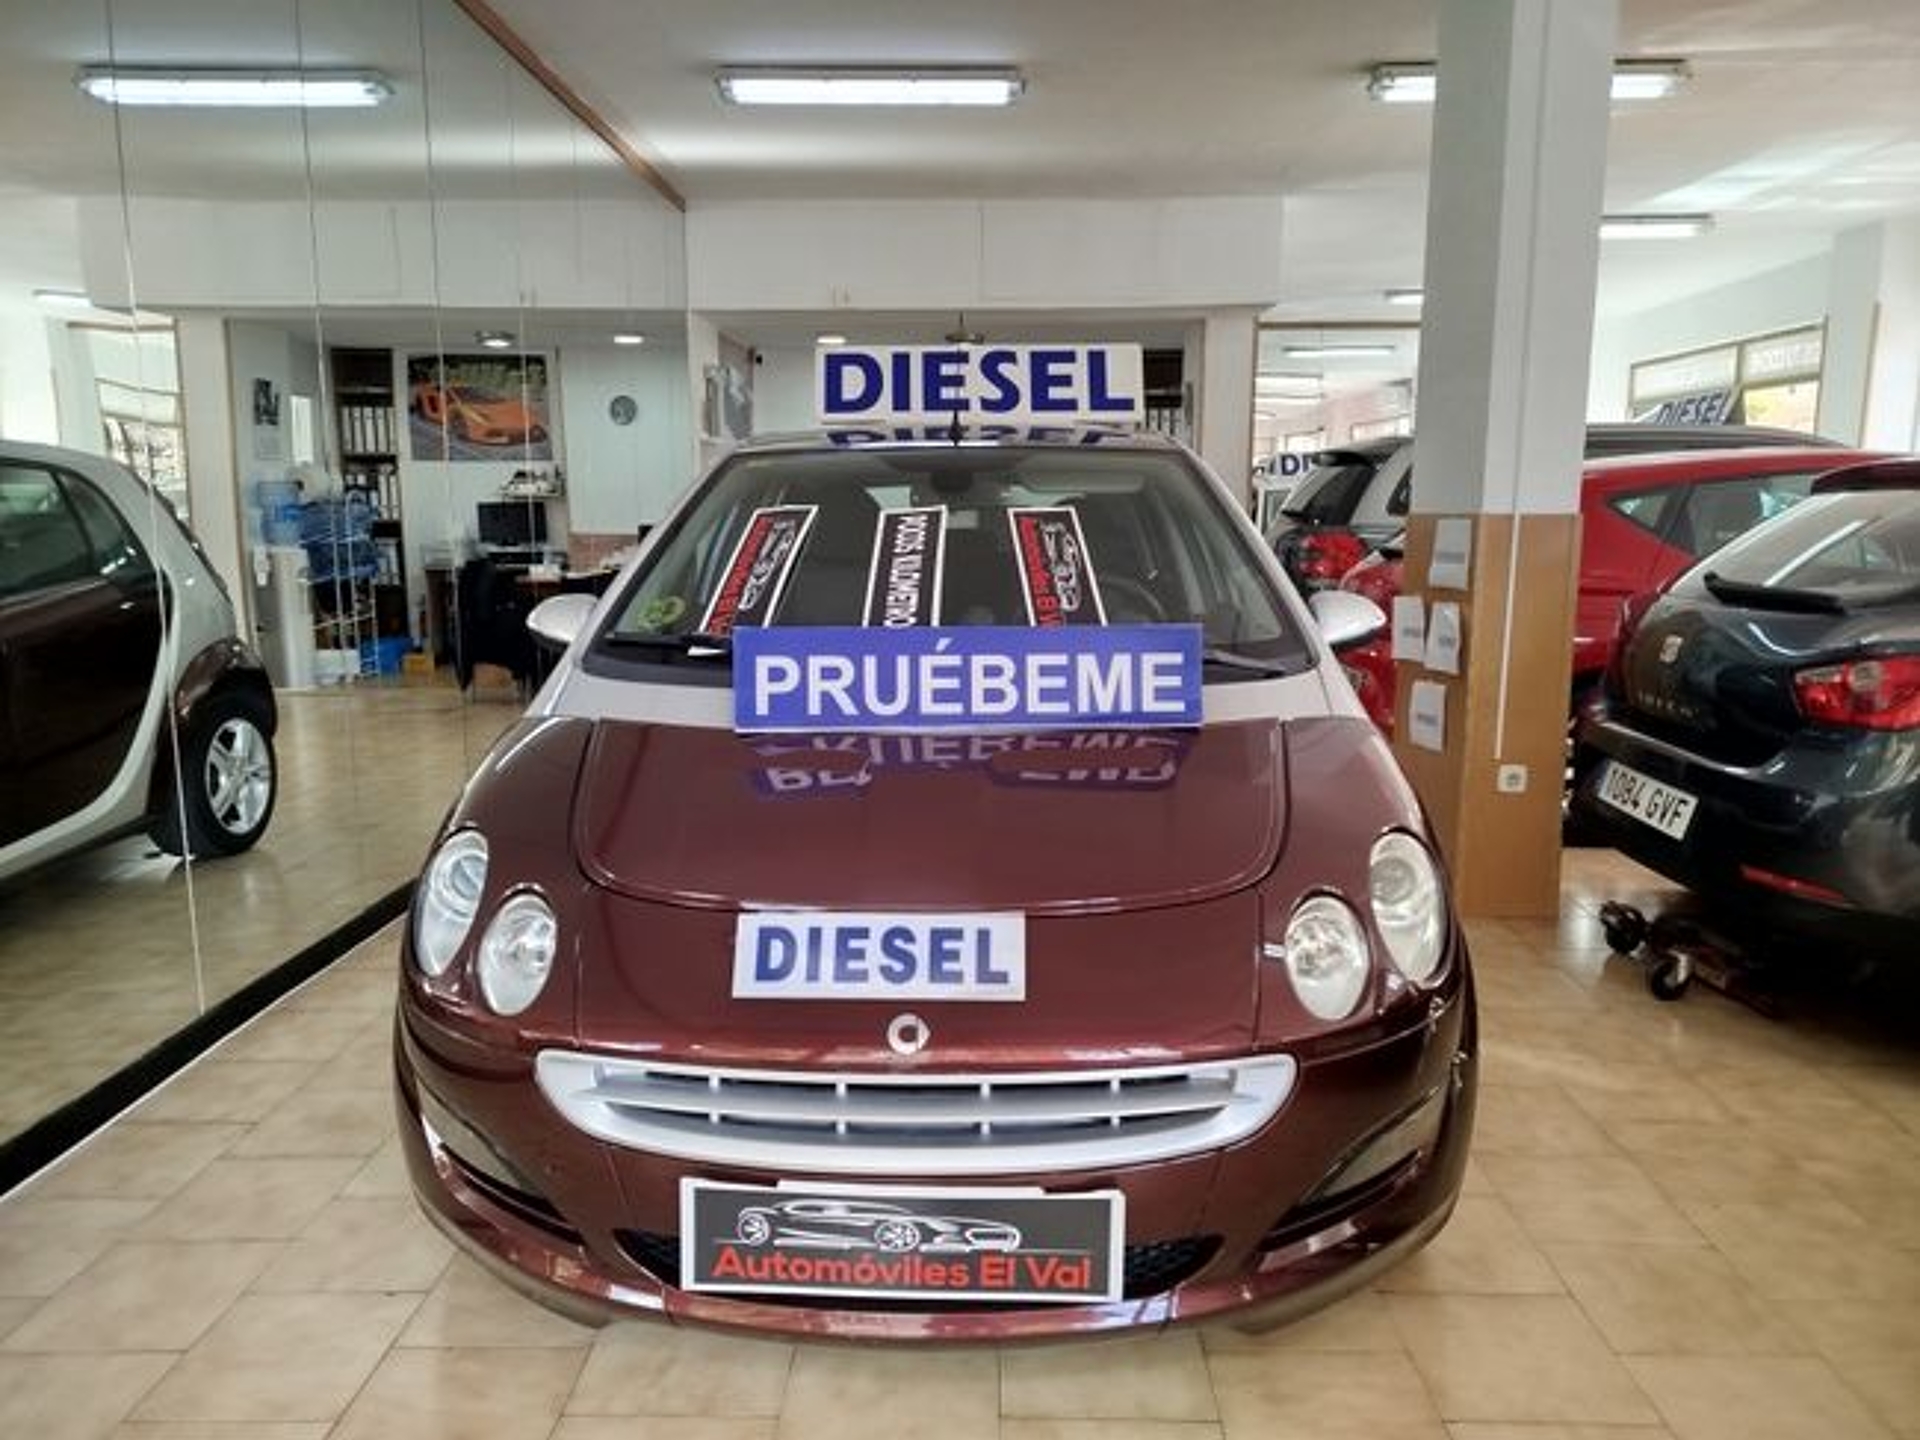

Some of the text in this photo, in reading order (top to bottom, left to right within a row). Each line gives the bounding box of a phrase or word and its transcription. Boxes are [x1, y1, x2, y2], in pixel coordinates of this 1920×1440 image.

[823, 349, 1136, 415] DIESEL
[754, 637, 1186, 716] PRUÉBEME
[755, 926, 1009, 984] DIESEL
[711, 1245, 969, 1287] Automóviles
[980, 1255, 1015, 1288] El
